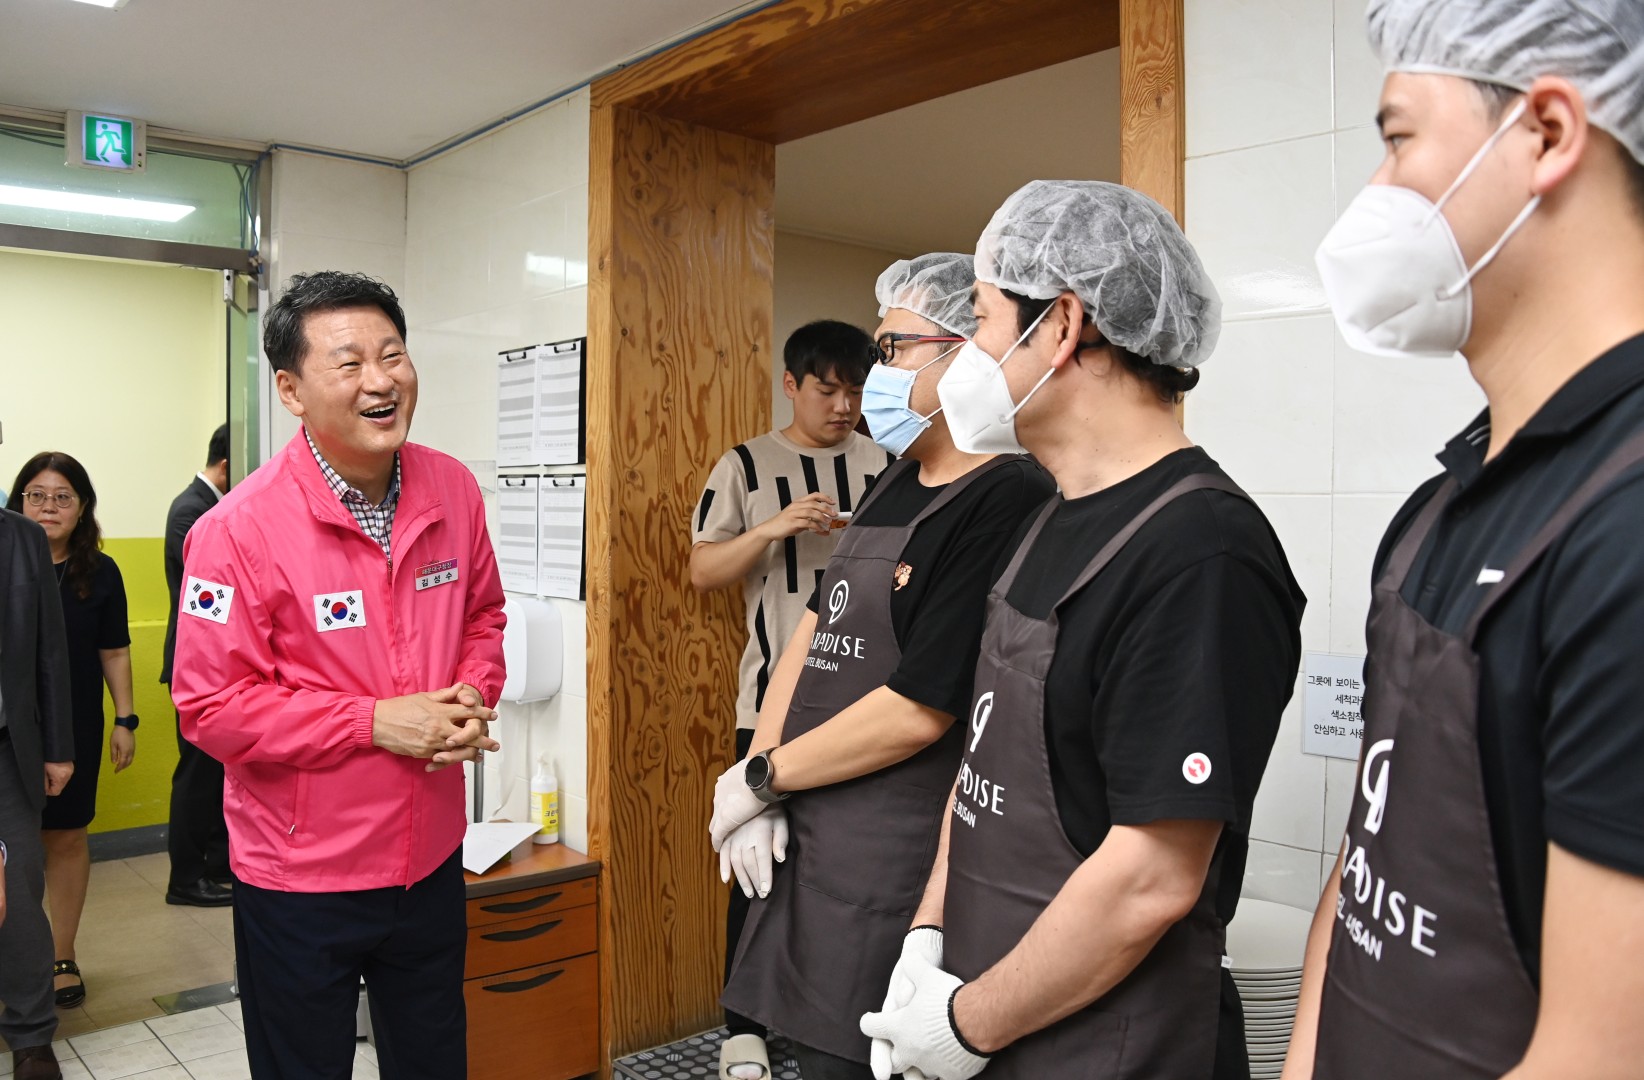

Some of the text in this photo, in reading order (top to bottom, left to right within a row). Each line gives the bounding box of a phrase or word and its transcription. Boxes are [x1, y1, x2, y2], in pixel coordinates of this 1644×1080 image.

[815, 658, 839, 672] BUSAN
[1307, 675, 1361, 690] 그릇에 보이는
[1313, 723, 1346, 737] 안심하고
[957, 758, 1005, 816] ADISE
[957, 801, 977, 828] BUSAN
[1345, 912, 1383, 962] USAN
